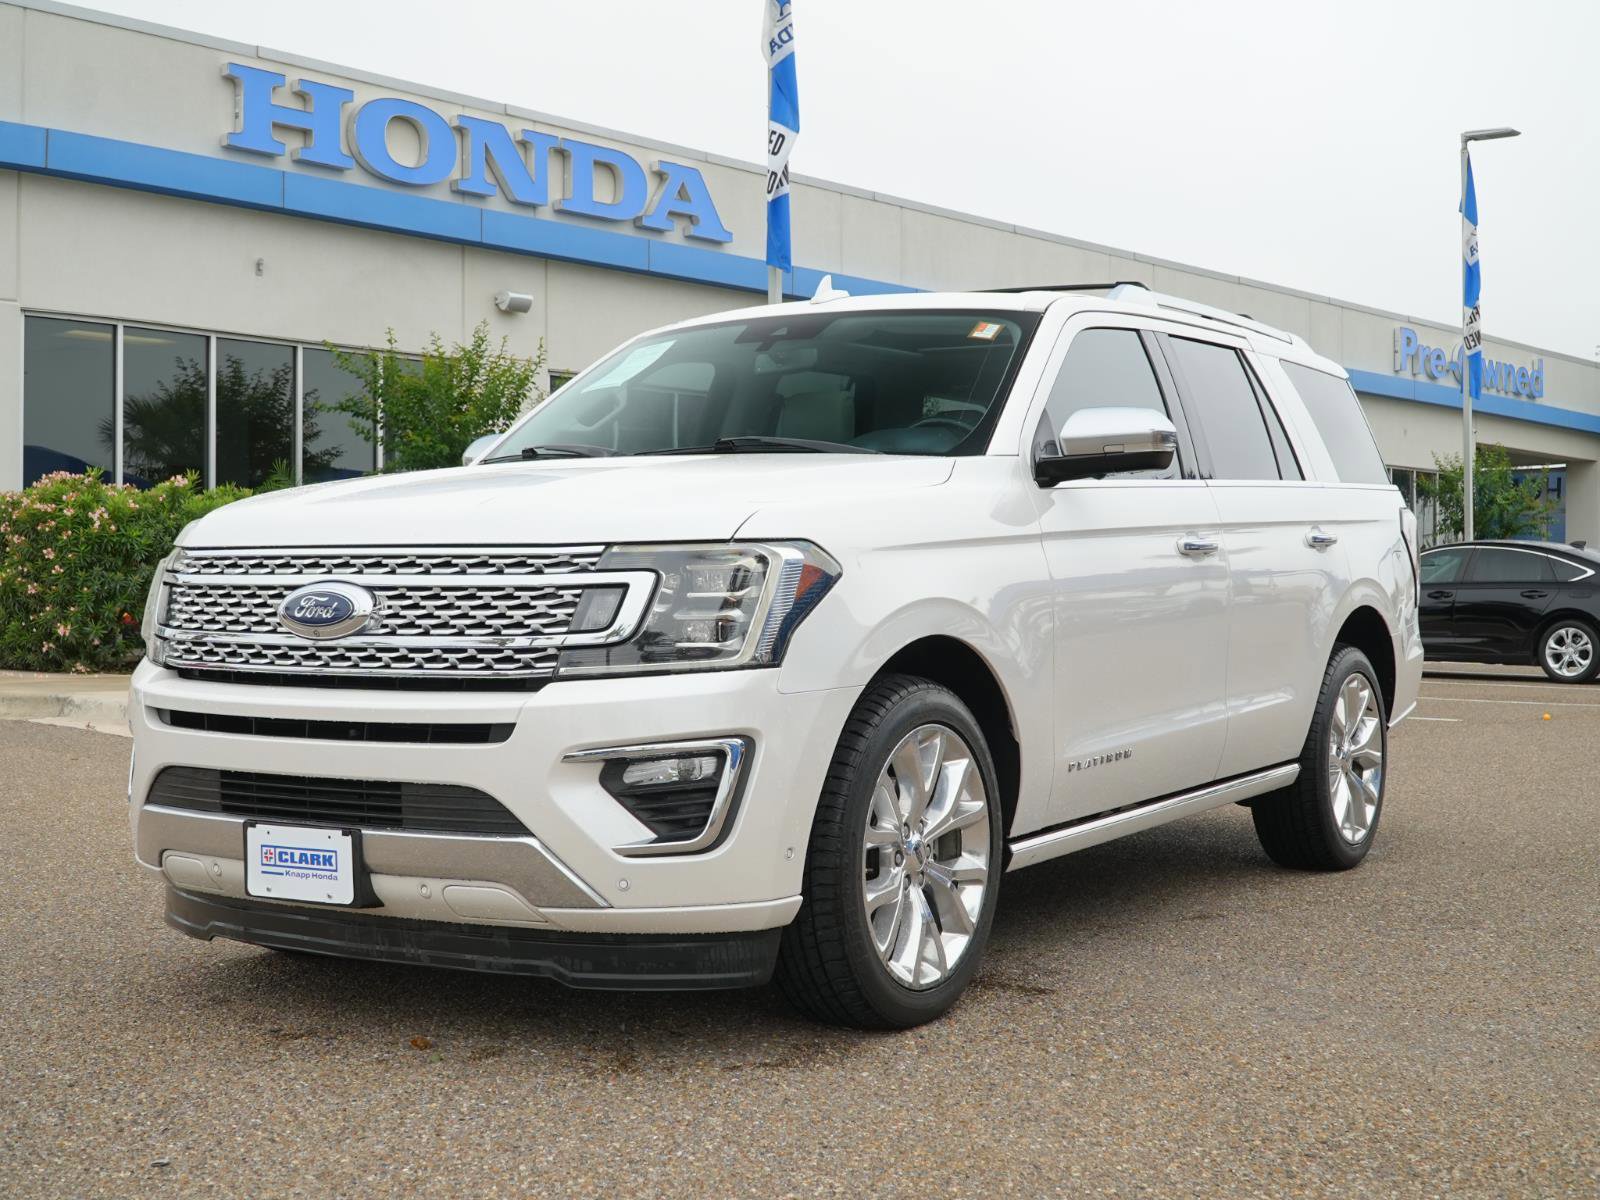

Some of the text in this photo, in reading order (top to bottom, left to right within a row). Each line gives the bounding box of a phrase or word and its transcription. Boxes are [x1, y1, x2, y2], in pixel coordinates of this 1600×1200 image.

[221, 62, 734, 243] HONDA
[294, 595, 338, 619] Ford
[1068, 748, 1132, 773] PLATINUM
[277, 850, 334, 867] CLARK
[285, 869, 338, 881] Knapp Honda
